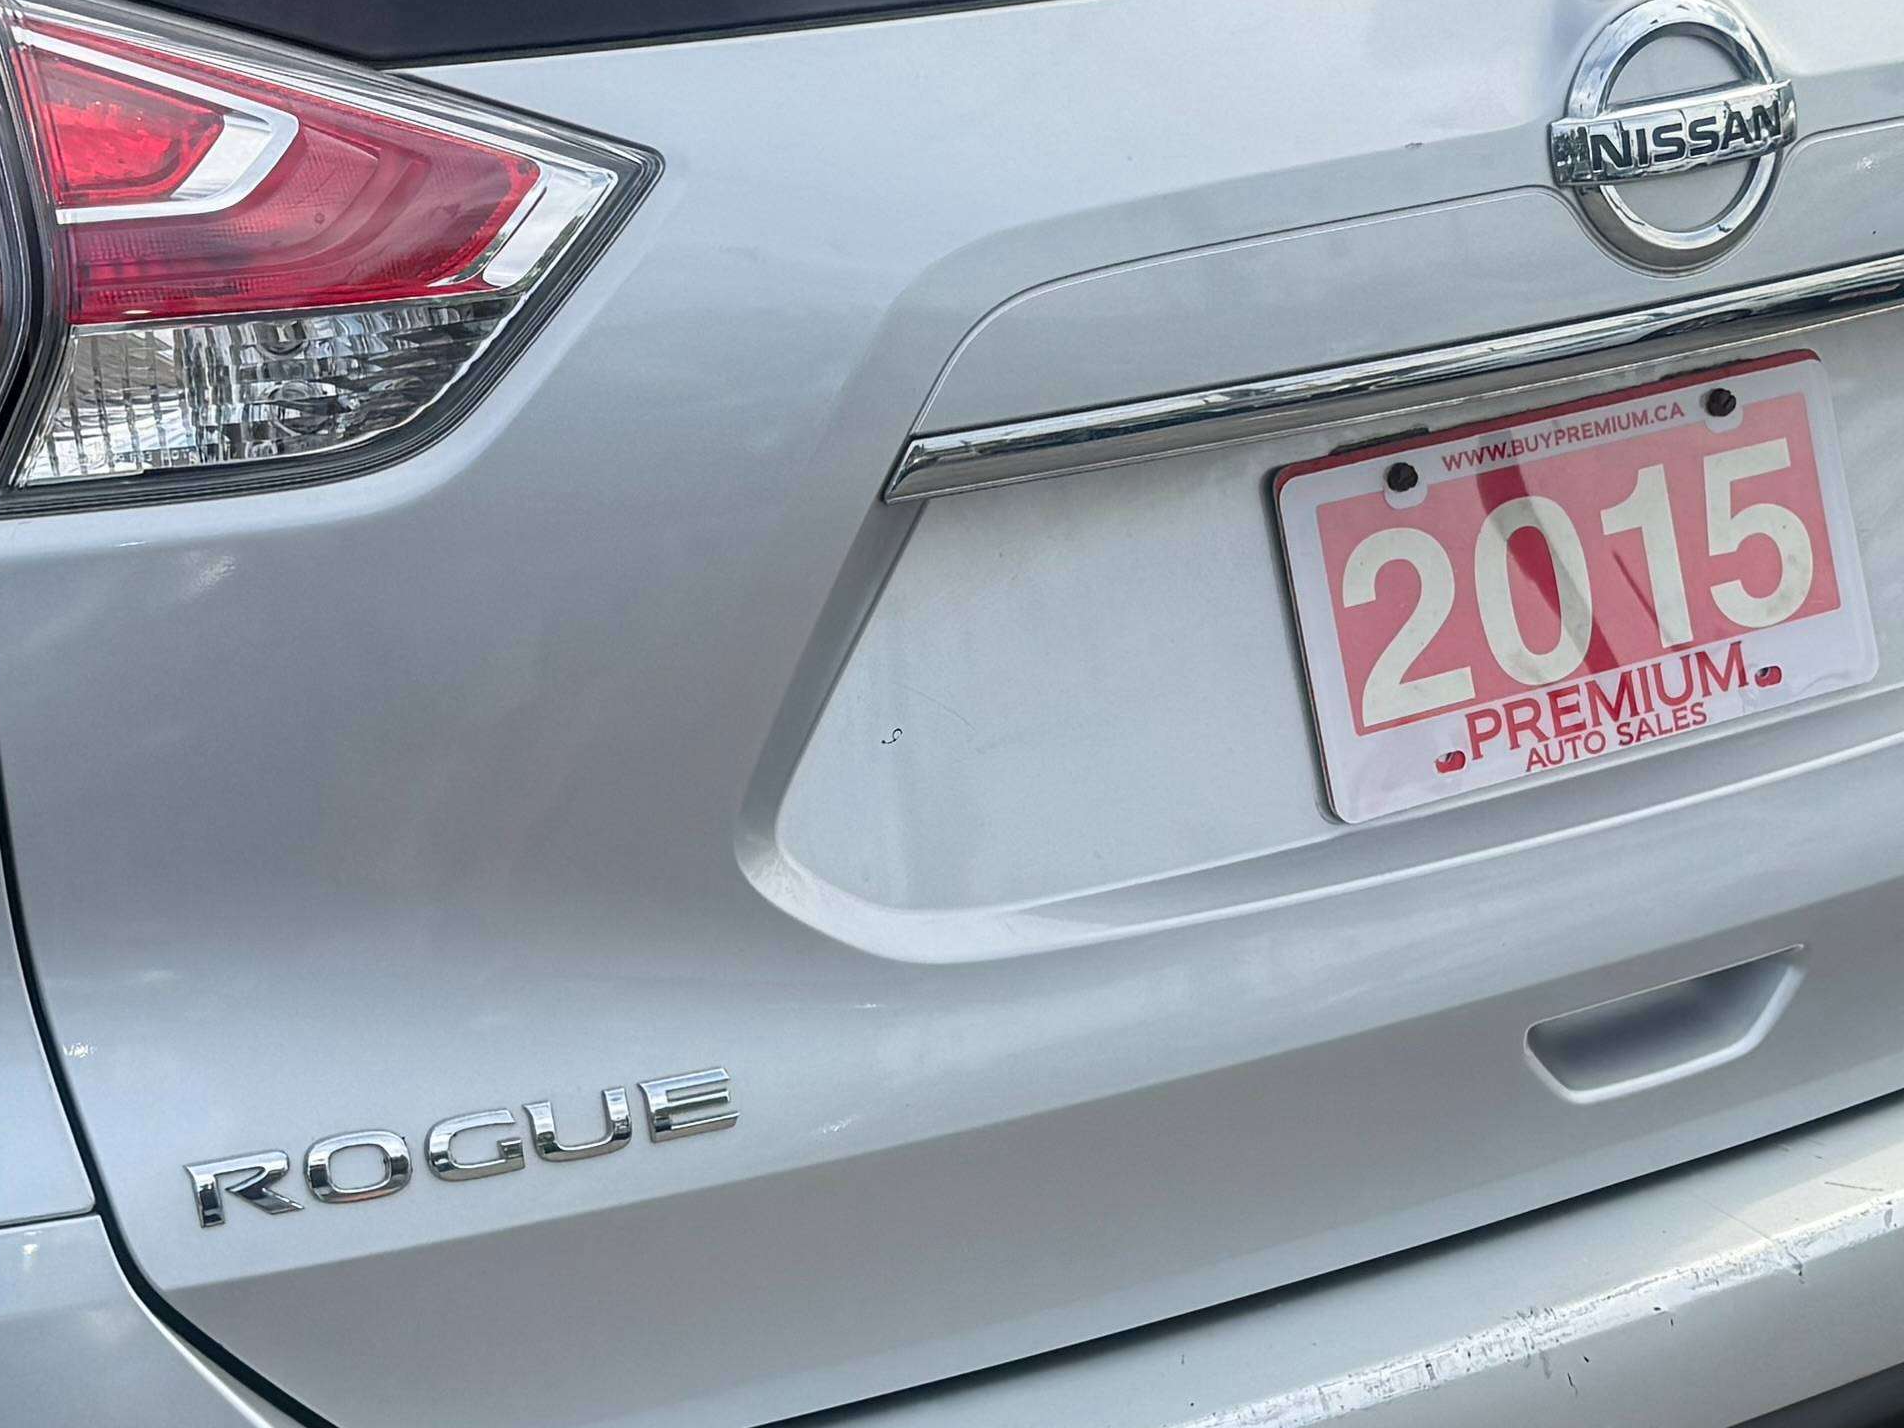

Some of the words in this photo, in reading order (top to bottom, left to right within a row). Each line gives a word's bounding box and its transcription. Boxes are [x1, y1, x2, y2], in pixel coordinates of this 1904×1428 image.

[1589, 99, 1783, 172] NISSAN
[1441, 402, 1685, 473] WWW.BUYPREMIUM.CA
[1341, 437, 1814, 728] 2015
[1466, 640, 1751, 761] PREMIUM
[1525, 729, 1607, 773] AUTO
[1617, 701, 1709, 748] SALES
[184, 1067, 741, 1229] ROGUE
